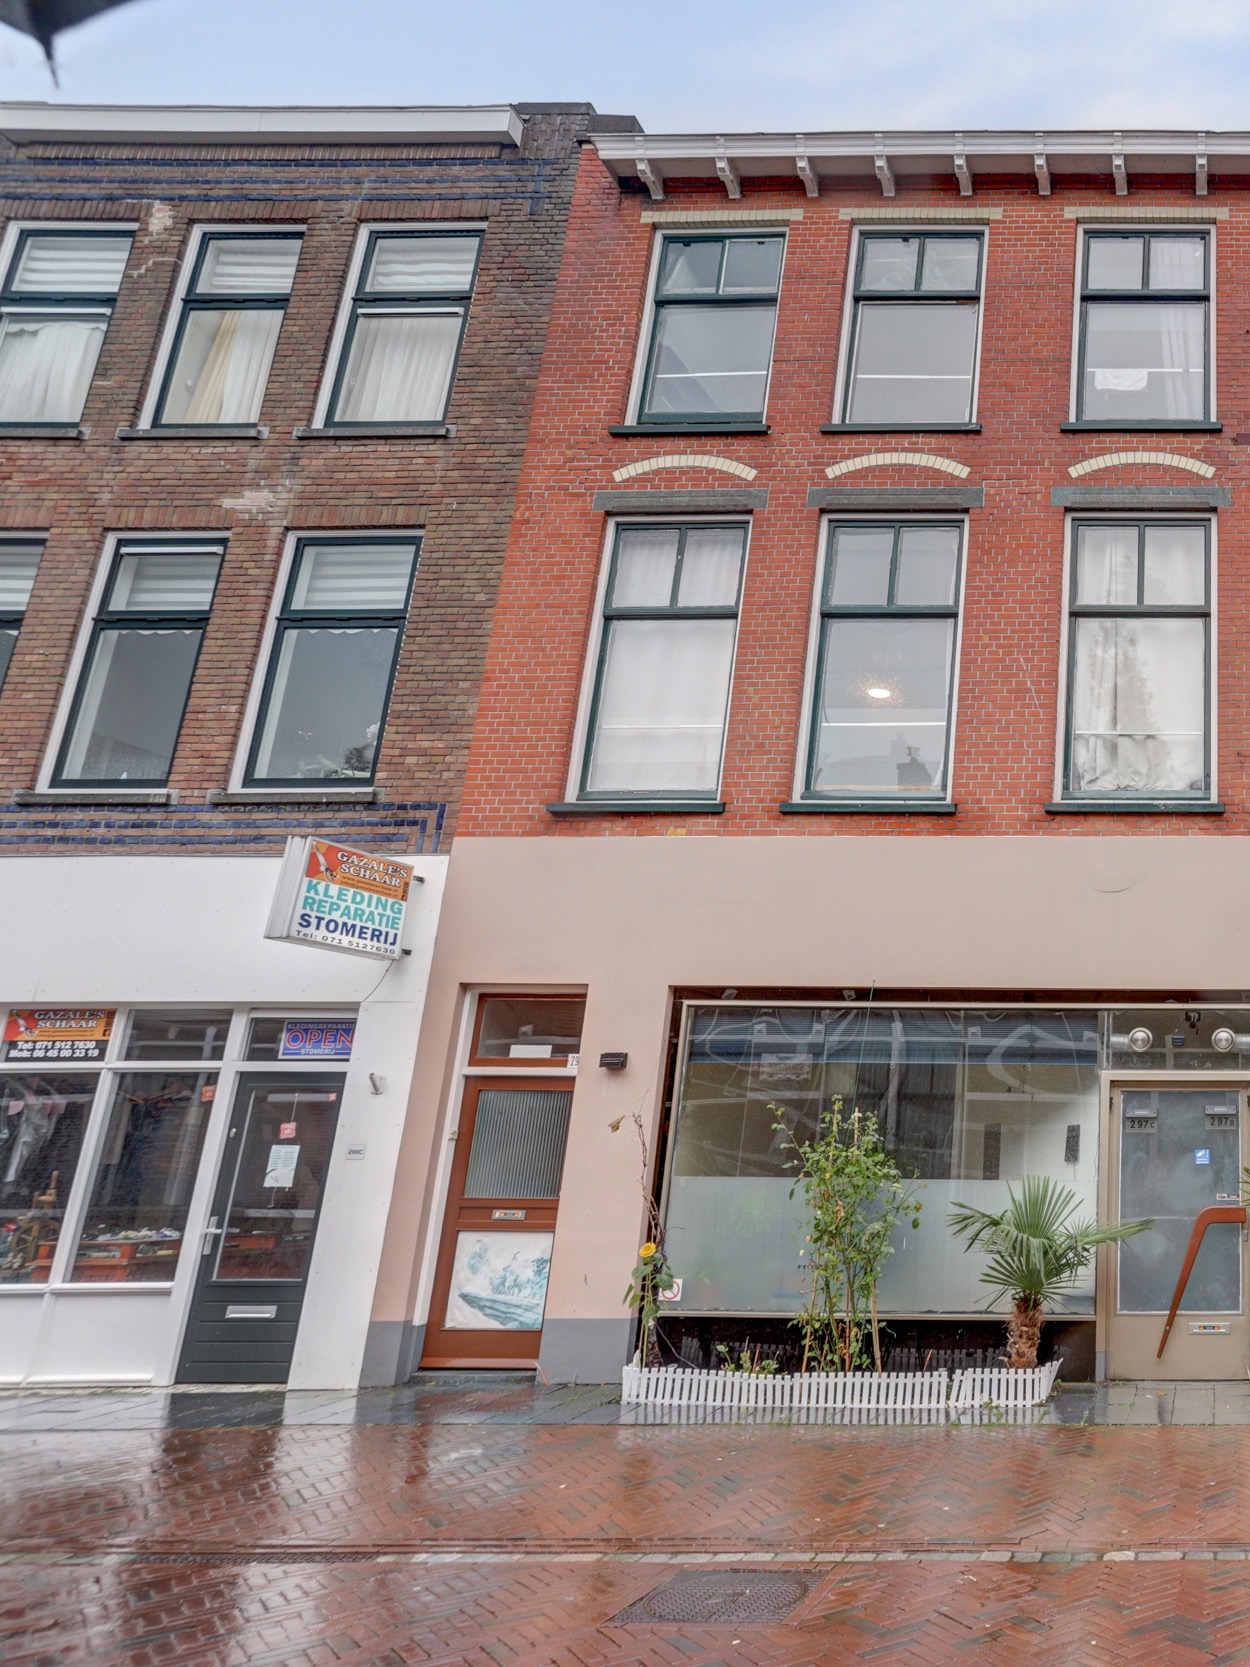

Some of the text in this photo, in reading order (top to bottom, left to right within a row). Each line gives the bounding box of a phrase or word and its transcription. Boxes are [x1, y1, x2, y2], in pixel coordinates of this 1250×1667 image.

[337, 851, 408, 878] GAZALE'S
[340, 863, 401, 887] SCHAAR
[306, 880, 403, 915] KLEDING
[302, 895, 402, 931] REPARATIE
[298, 913, 398, 946] STOMERIJ
[295, 930, 396, 955] Tel: 071 5127630
[34, 1011, 105, 1019] GAZALE'S
[37, 1020, 97, 1028] SCHAAR
[35, 1041, 52, 1049] 071
[54, 1041, 72, 1049] 512
[286, 1029, 355, 1049] OPEN
